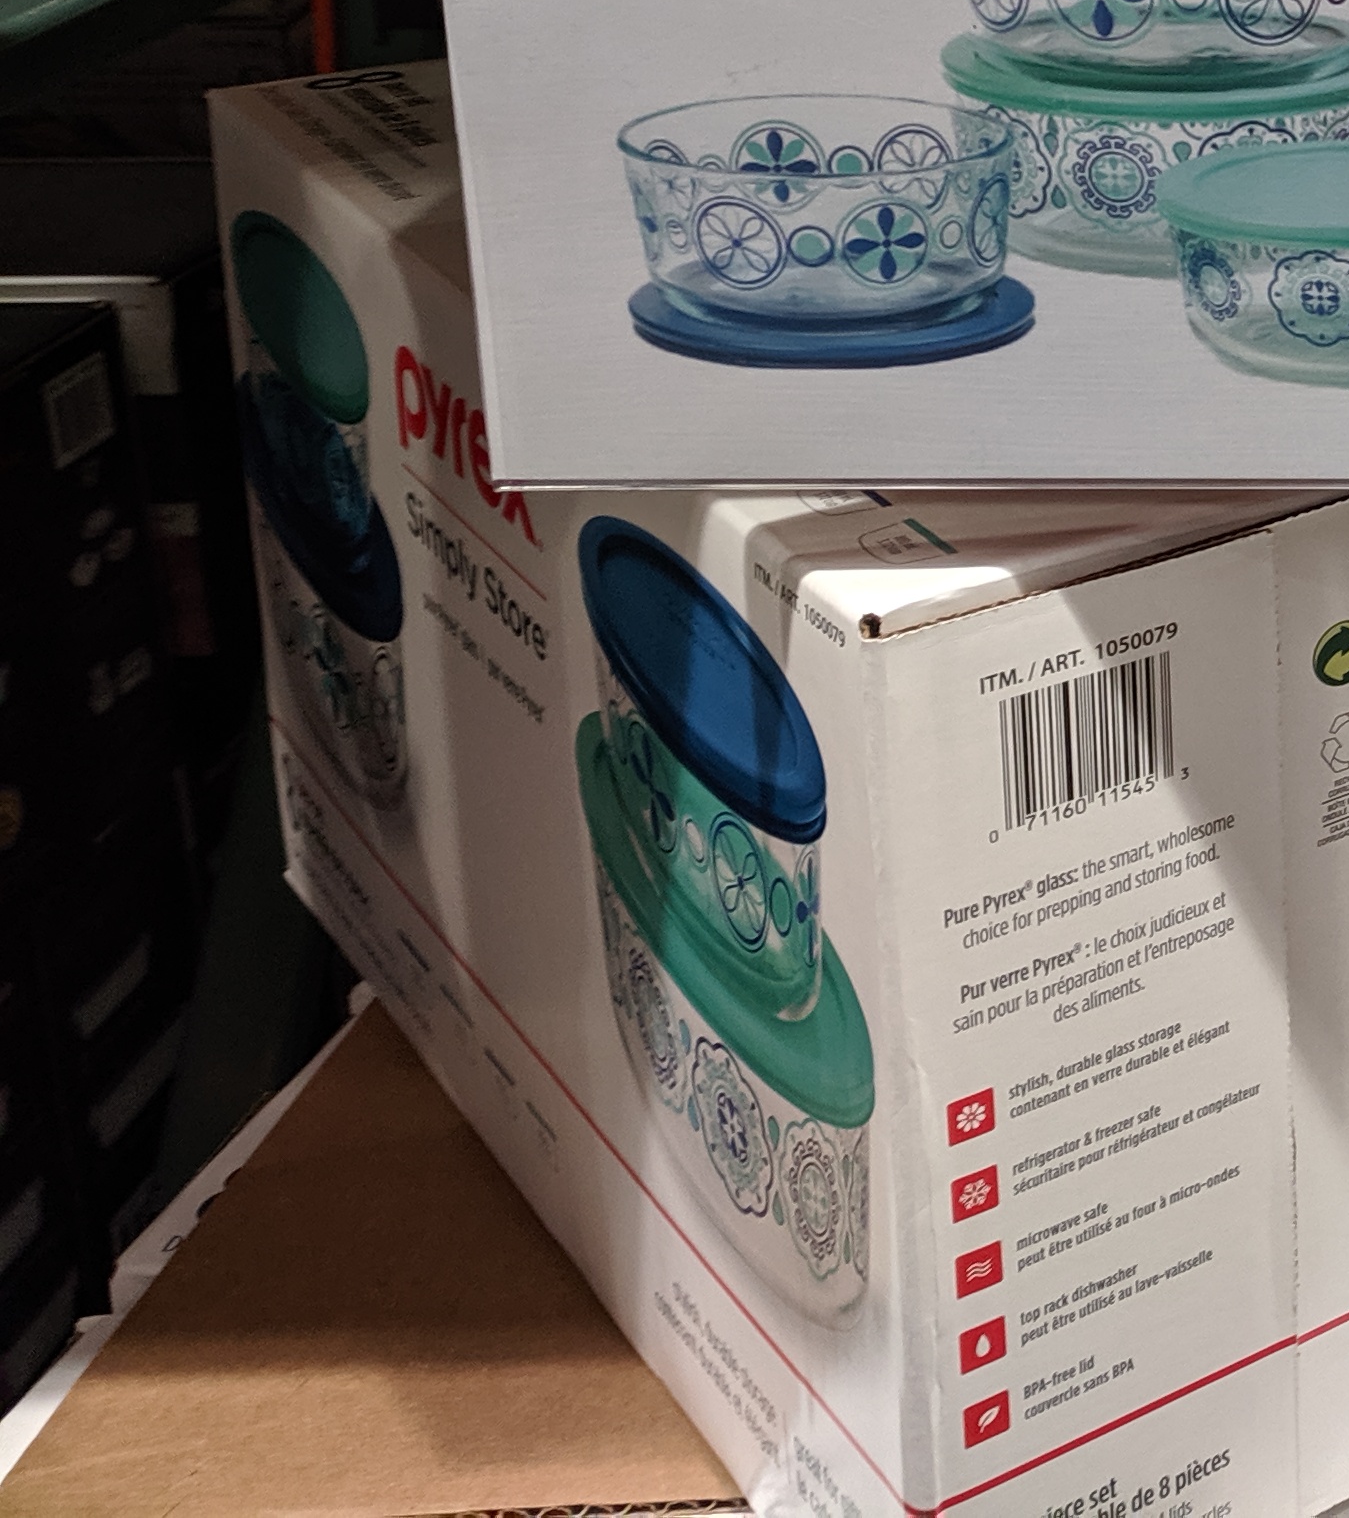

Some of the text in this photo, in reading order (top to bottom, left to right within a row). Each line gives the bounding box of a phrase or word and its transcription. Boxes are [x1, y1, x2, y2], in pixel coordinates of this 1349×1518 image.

[405, 491, 479, 602] Simply
[482, 566, 547, 661] Store
[979, 668, 1024, 695] ITM.
[1040, 648, 1085, 678] ART.
[1094, 621, 1179, 661] 1050079
[943, 903, 980, 929] Pure
[1036, 867, 1080, 899] glass:
[1081, 857, 1107, 880] the
[1108, 840, 1155, 872] smart,
[1156, 813, 1236, 854] wholesome
[962, 842, 1221, 950] choice for prepping and storing food.
[960, 984, 987, 1004] Pur
[989, 965, 1030, 993] verre
[1093, 936, 1108, 956] le
[1109, 920, 1148, 949] choix
[1148, 900, 1210, 939] judicieux
[1212, 890, 1227, 911] et
[952, 1009, 985, 1035] sain
[986, 994, 1022, 1025] pour
[1025, 988, 1039, 1007] la
[1041, 956, 1125, 1004] préparation
[1126, 948, 1142, 969] et
[1053, 975, 1147, 1024] des aliments.
[1007, 1021, 1182, 1101] stylish, durable glass storage
[1011, 1103, 1162, 1177] refrigerator & freezer safe
[1022, 1354, 1096, 1401] BPA-free lid
